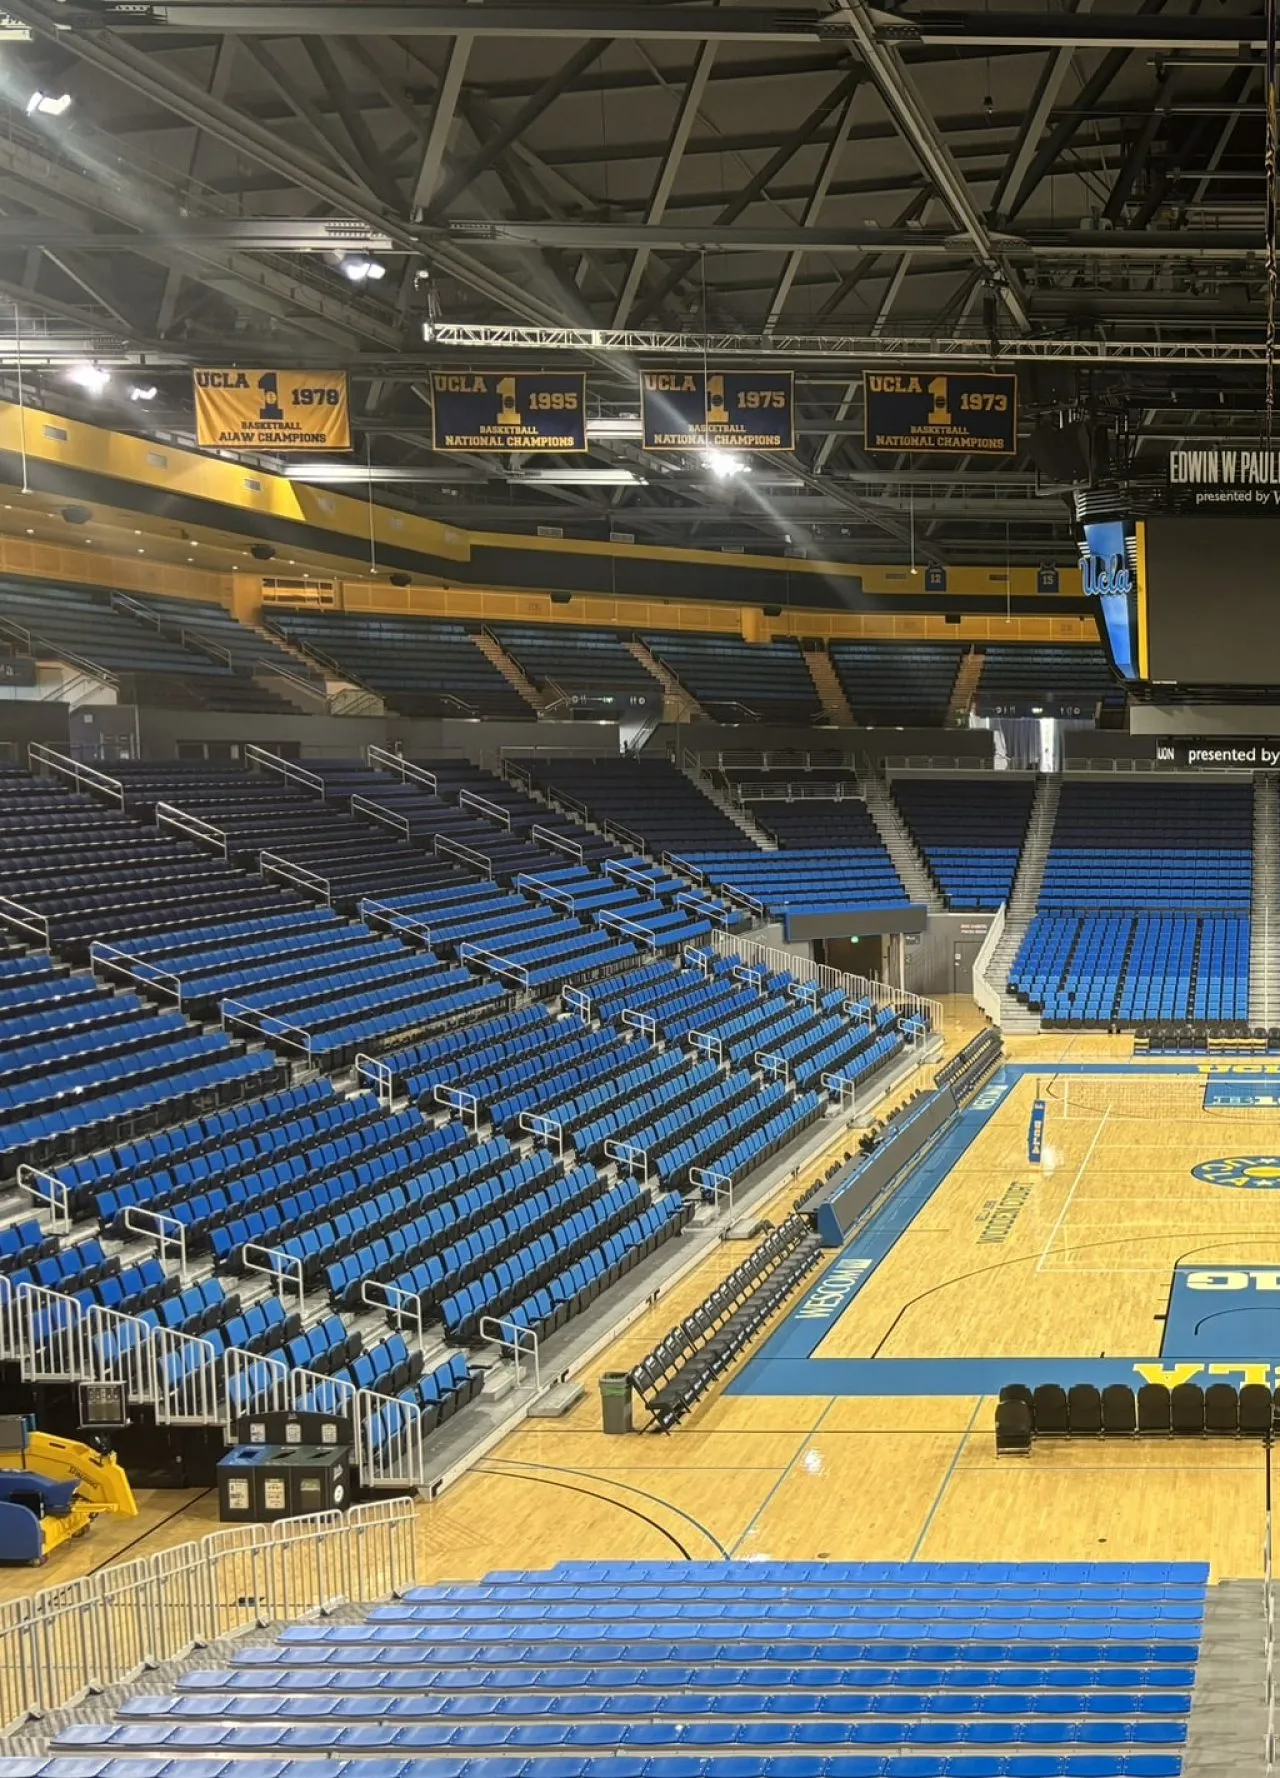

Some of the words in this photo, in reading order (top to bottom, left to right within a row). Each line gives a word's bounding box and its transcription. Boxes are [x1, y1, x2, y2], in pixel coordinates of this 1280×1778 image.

[197, 372, 249, 388] UCLA
[434, 375, 487, 392] UCLA
[644, 375, 696, 392] UCLA
[869, 376, 922, 393] UCLA
[529, 393, 577, 410] 1995
[737, 391, 786, 408] 1975
[960, 394, 1008, 411] 1973
[241, 422, 302, 430] BASKETBALL
[480, 426, 539, 435] BASKETBALL
[688, 424, 746, 433] BASKETBALL
[911, 425, 969, 435] BASKETBALL
[219, 432, 255, 442] AIAW
[258, 432, 326, 443] CHAMPIONS
[445, 436, 505, 446] NATIONAL
[506, 436, 574, 447] CHAMPIONS
[654, 434, 711, 445] NATIONAL
[714, 435, 781, 445] CHAMPIONS
[876, 435, 936, 446] NATIONAL
[937, 436, 1004, 449] CHAMPIONS
[1170, 451, 1219, 483] EDWIN
[1221, 451, 1237, 483] W
[1196, 490, 1252, 504] presented
[1255, 490, 1271, 504] by
[1188, 748, 1256, 764] presented
[1261, 748, 1280, 765] by
[795, 1269, 864, 1319] WESCOM
